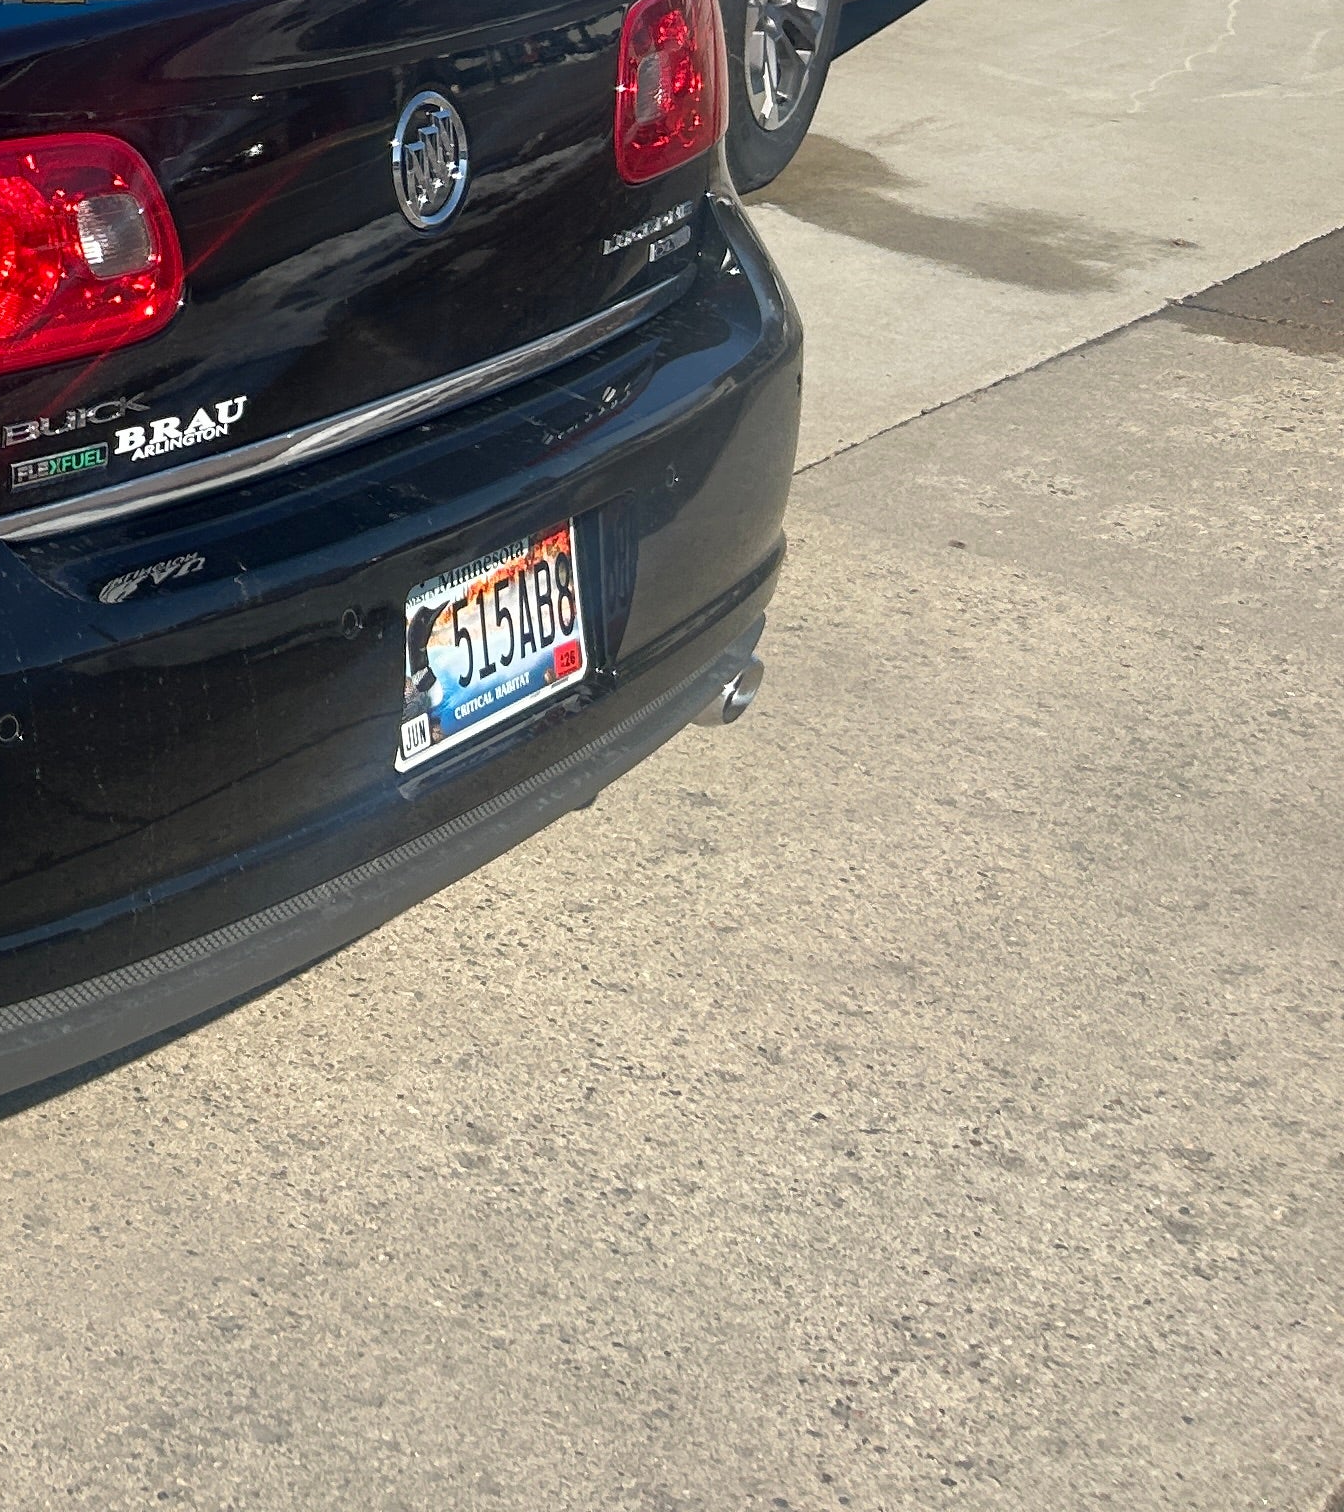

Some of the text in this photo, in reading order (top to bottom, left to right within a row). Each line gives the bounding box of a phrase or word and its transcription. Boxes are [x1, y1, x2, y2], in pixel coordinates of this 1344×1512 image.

[2, 392, 150, 448] BUICK
[114, 395, 248, 455] BRAU
[131, 422, 229, 461] ARLINGTON
[438, 540, 524, 590] Minnesota
[452, 552, 575, 688] 515AB8
[454, 671, 530, 720] CRITICAL HABITAT
[406, 720, 426, 751] JUN
